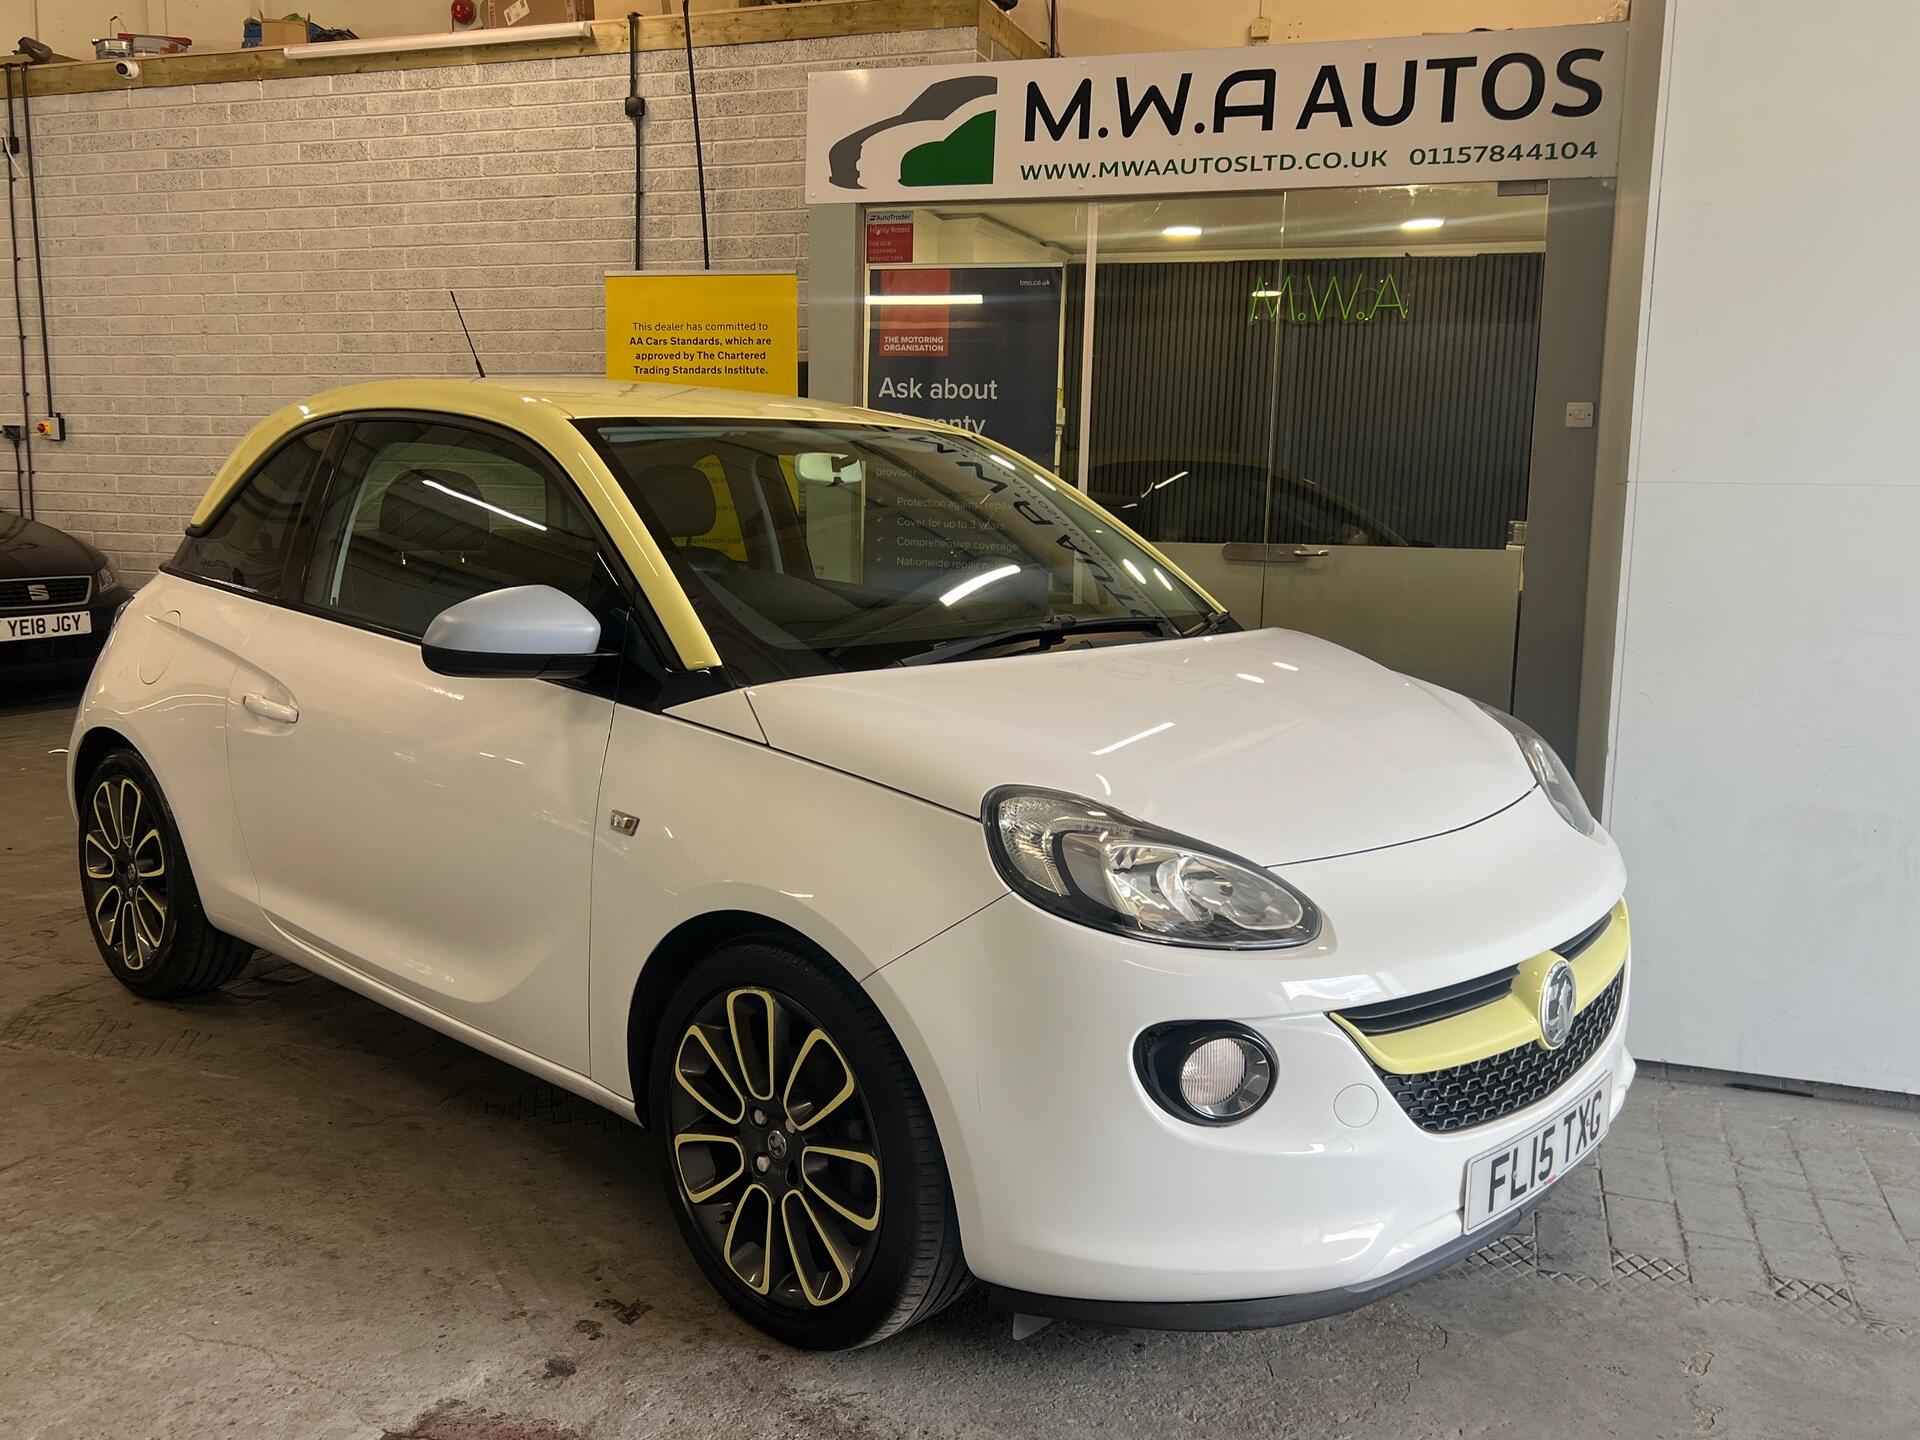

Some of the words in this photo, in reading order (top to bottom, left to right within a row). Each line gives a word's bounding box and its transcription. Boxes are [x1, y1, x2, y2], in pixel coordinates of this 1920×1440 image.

[1024, 68, 1277, 142] M.W.A
[1295, 48, 1605, 130] AUTOS
[1020, 150, 1388, 181] WWW.MWAAUTOSLTD.CO.UK
[1409, 141, 1598, 166] 01157844104
[1019, 279, 1051, 287] tmo.co.uk
[632, 322, 652, 331] This
[654, 322, 684, 331] dealer
[686, 322, 703, 331] has
[705, 322, 757, 331] committed
[758, 322, 769, 331] to
[629, 337, 644, 346] AA
[645, 337, 668, 346] Cars
[670, 336, 723, 346] Standards,
[725, 336, 754, 346] which
[756, 338, 772, 346] are
[884, 336, 899, 344] THE
[900, 336, 944, 344] MOTORING
[884, 344, 944, 352] ORGANISATION
[635, 351, 681, 361] approved
[683, 351, 695, 361] by
[697, 351, 715, 360] The
[717, 351, 767, 360] Chartered
[633, 365, 670, 376] Trading
[672, 365, 722, 375] Standards
[724, 365, 769, 375] Institute.
[878, 376, 923, 400] Ask
[929, 378, 998, 400] about
[876, 467, 917, 478] provider
[897, 496, 946, 507] Protection
[896, 516, 926, 528] Cover
[928, 517, 941, 528] for
[943, 520, 956, 530] up
[958, 520, 967, 529] to
[970, 520, 976, 529] 3
[896, 536, 970, 549] Comprehensive
[973, 542, 1018, 553] coverage
[896, 556, 951, 568] Nationwide
[7, 618, 46, 637] YE18
[51, 614, 81, 633] JGY
[1488, 1124, 1556, 1213] FL15
[1563, 1089, 1602, 1164] TXG
